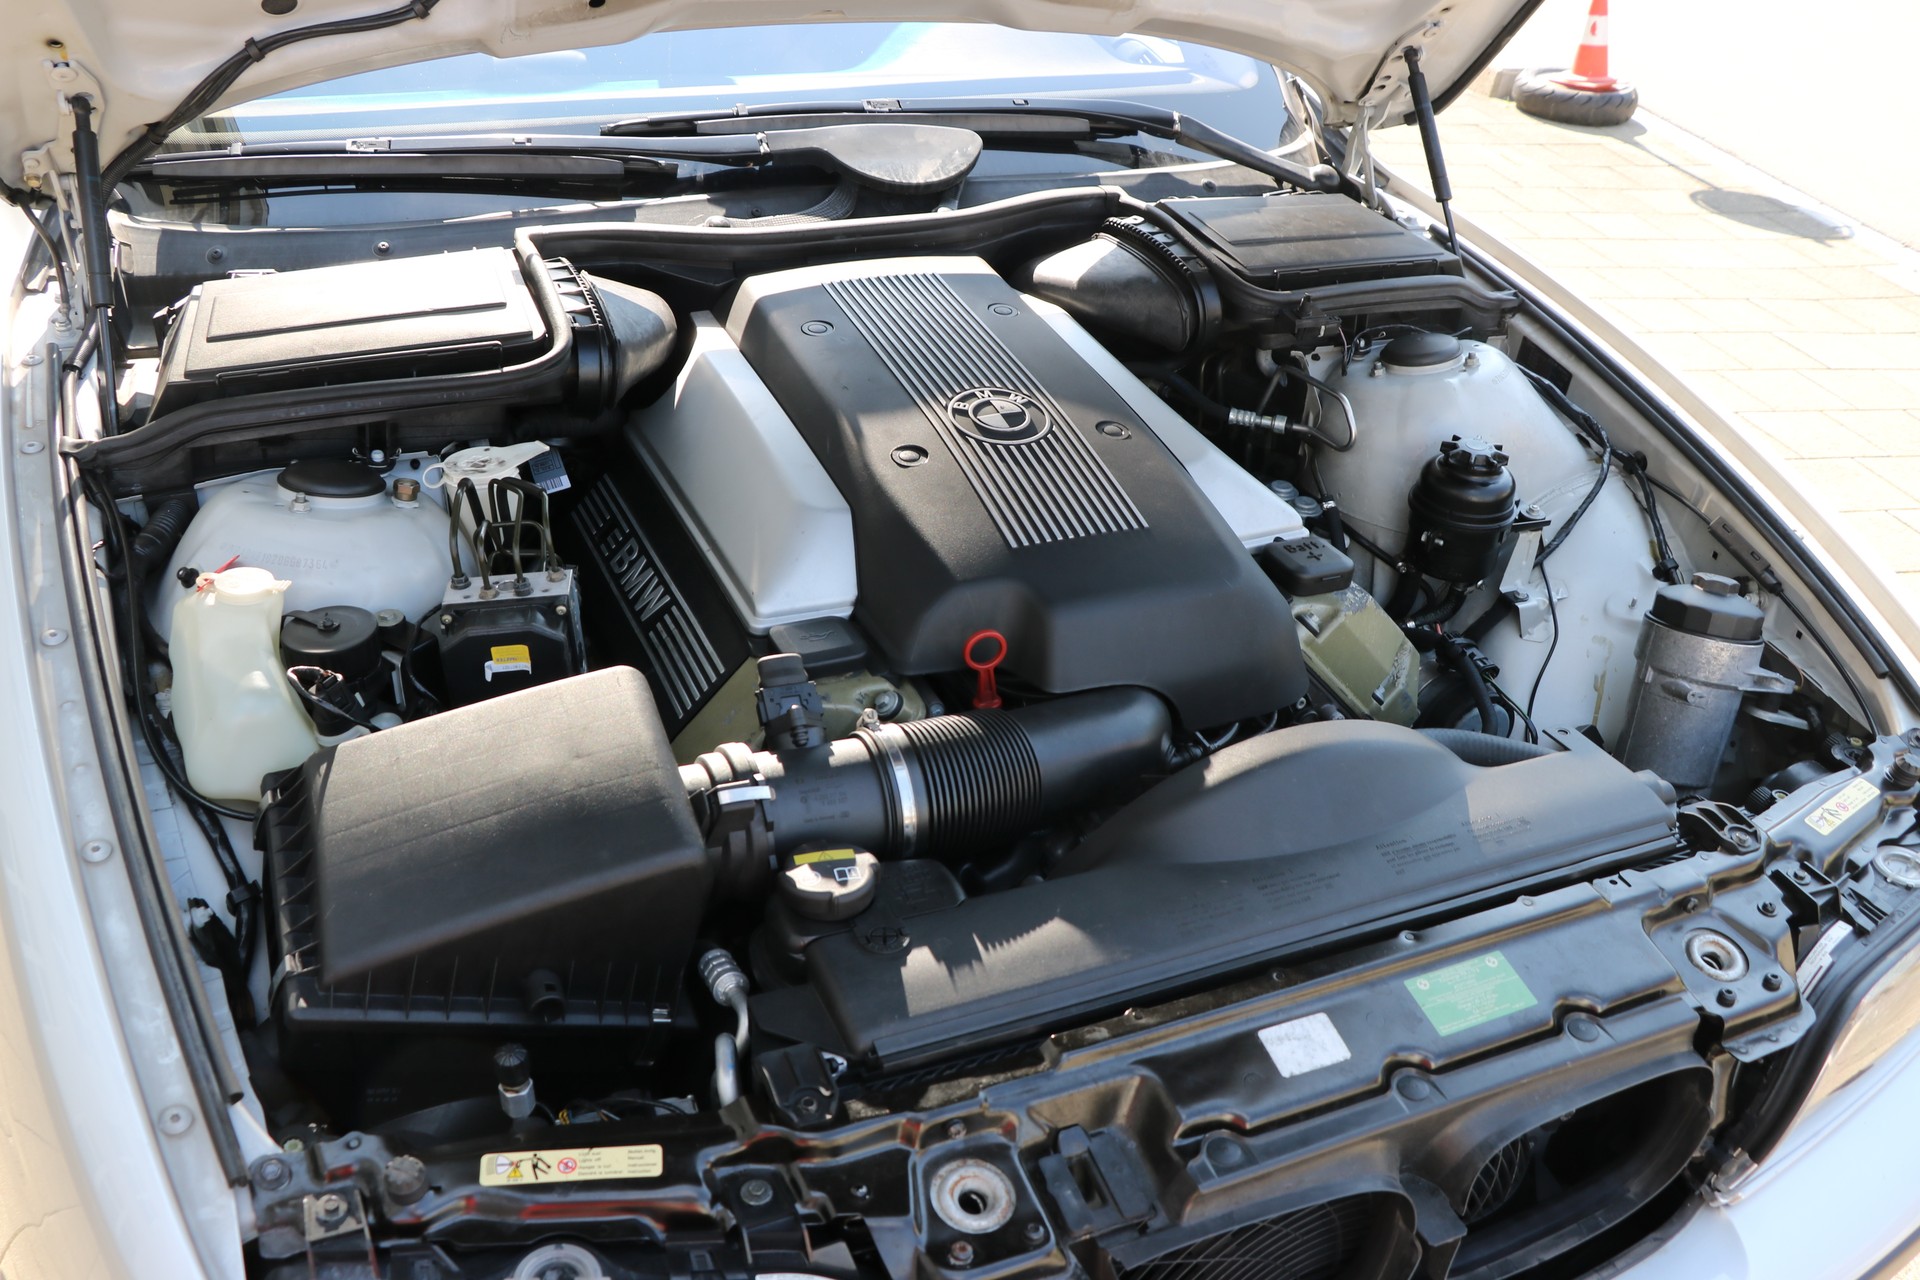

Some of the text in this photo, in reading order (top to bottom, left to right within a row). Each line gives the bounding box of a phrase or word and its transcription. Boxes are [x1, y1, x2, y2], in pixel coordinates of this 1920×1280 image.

[953, 389, 1029, 411] BMW
[1283, 541, 1326, 554] Batt.
[609, 537, 671, 622] BMW
